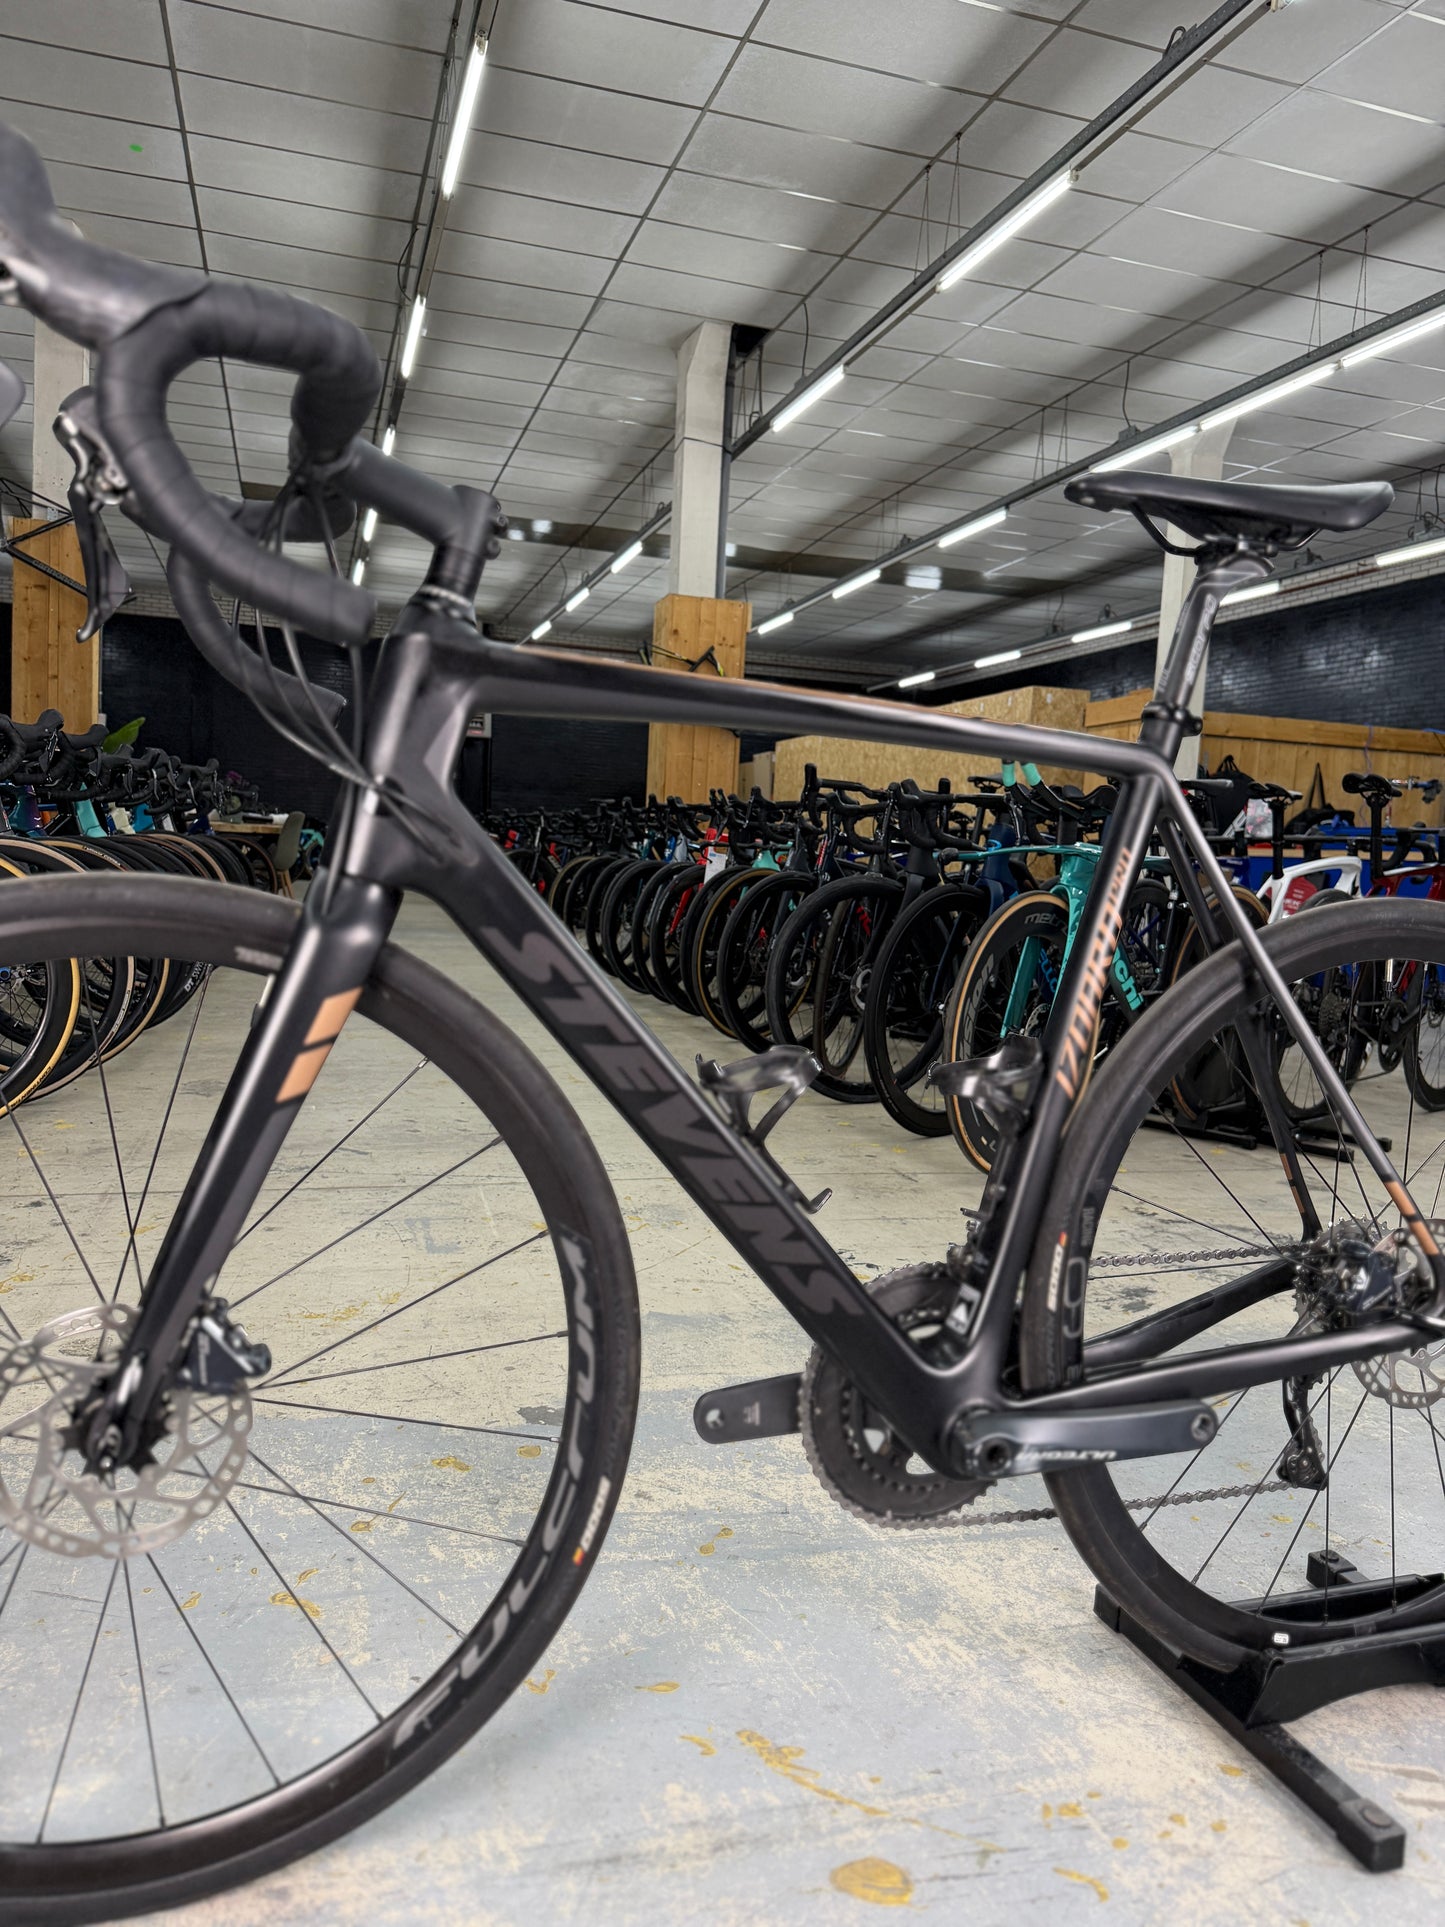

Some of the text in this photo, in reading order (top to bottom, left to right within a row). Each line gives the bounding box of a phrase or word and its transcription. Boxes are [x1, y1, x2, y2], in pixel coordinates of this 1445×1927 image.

[184, 978, 195, 992] DT
[1056, 905, 1123, 1099] IZOARD
[479, 926, 866, 1316] STEVENS
[1046, 1243, 1065, 1313] 5000
